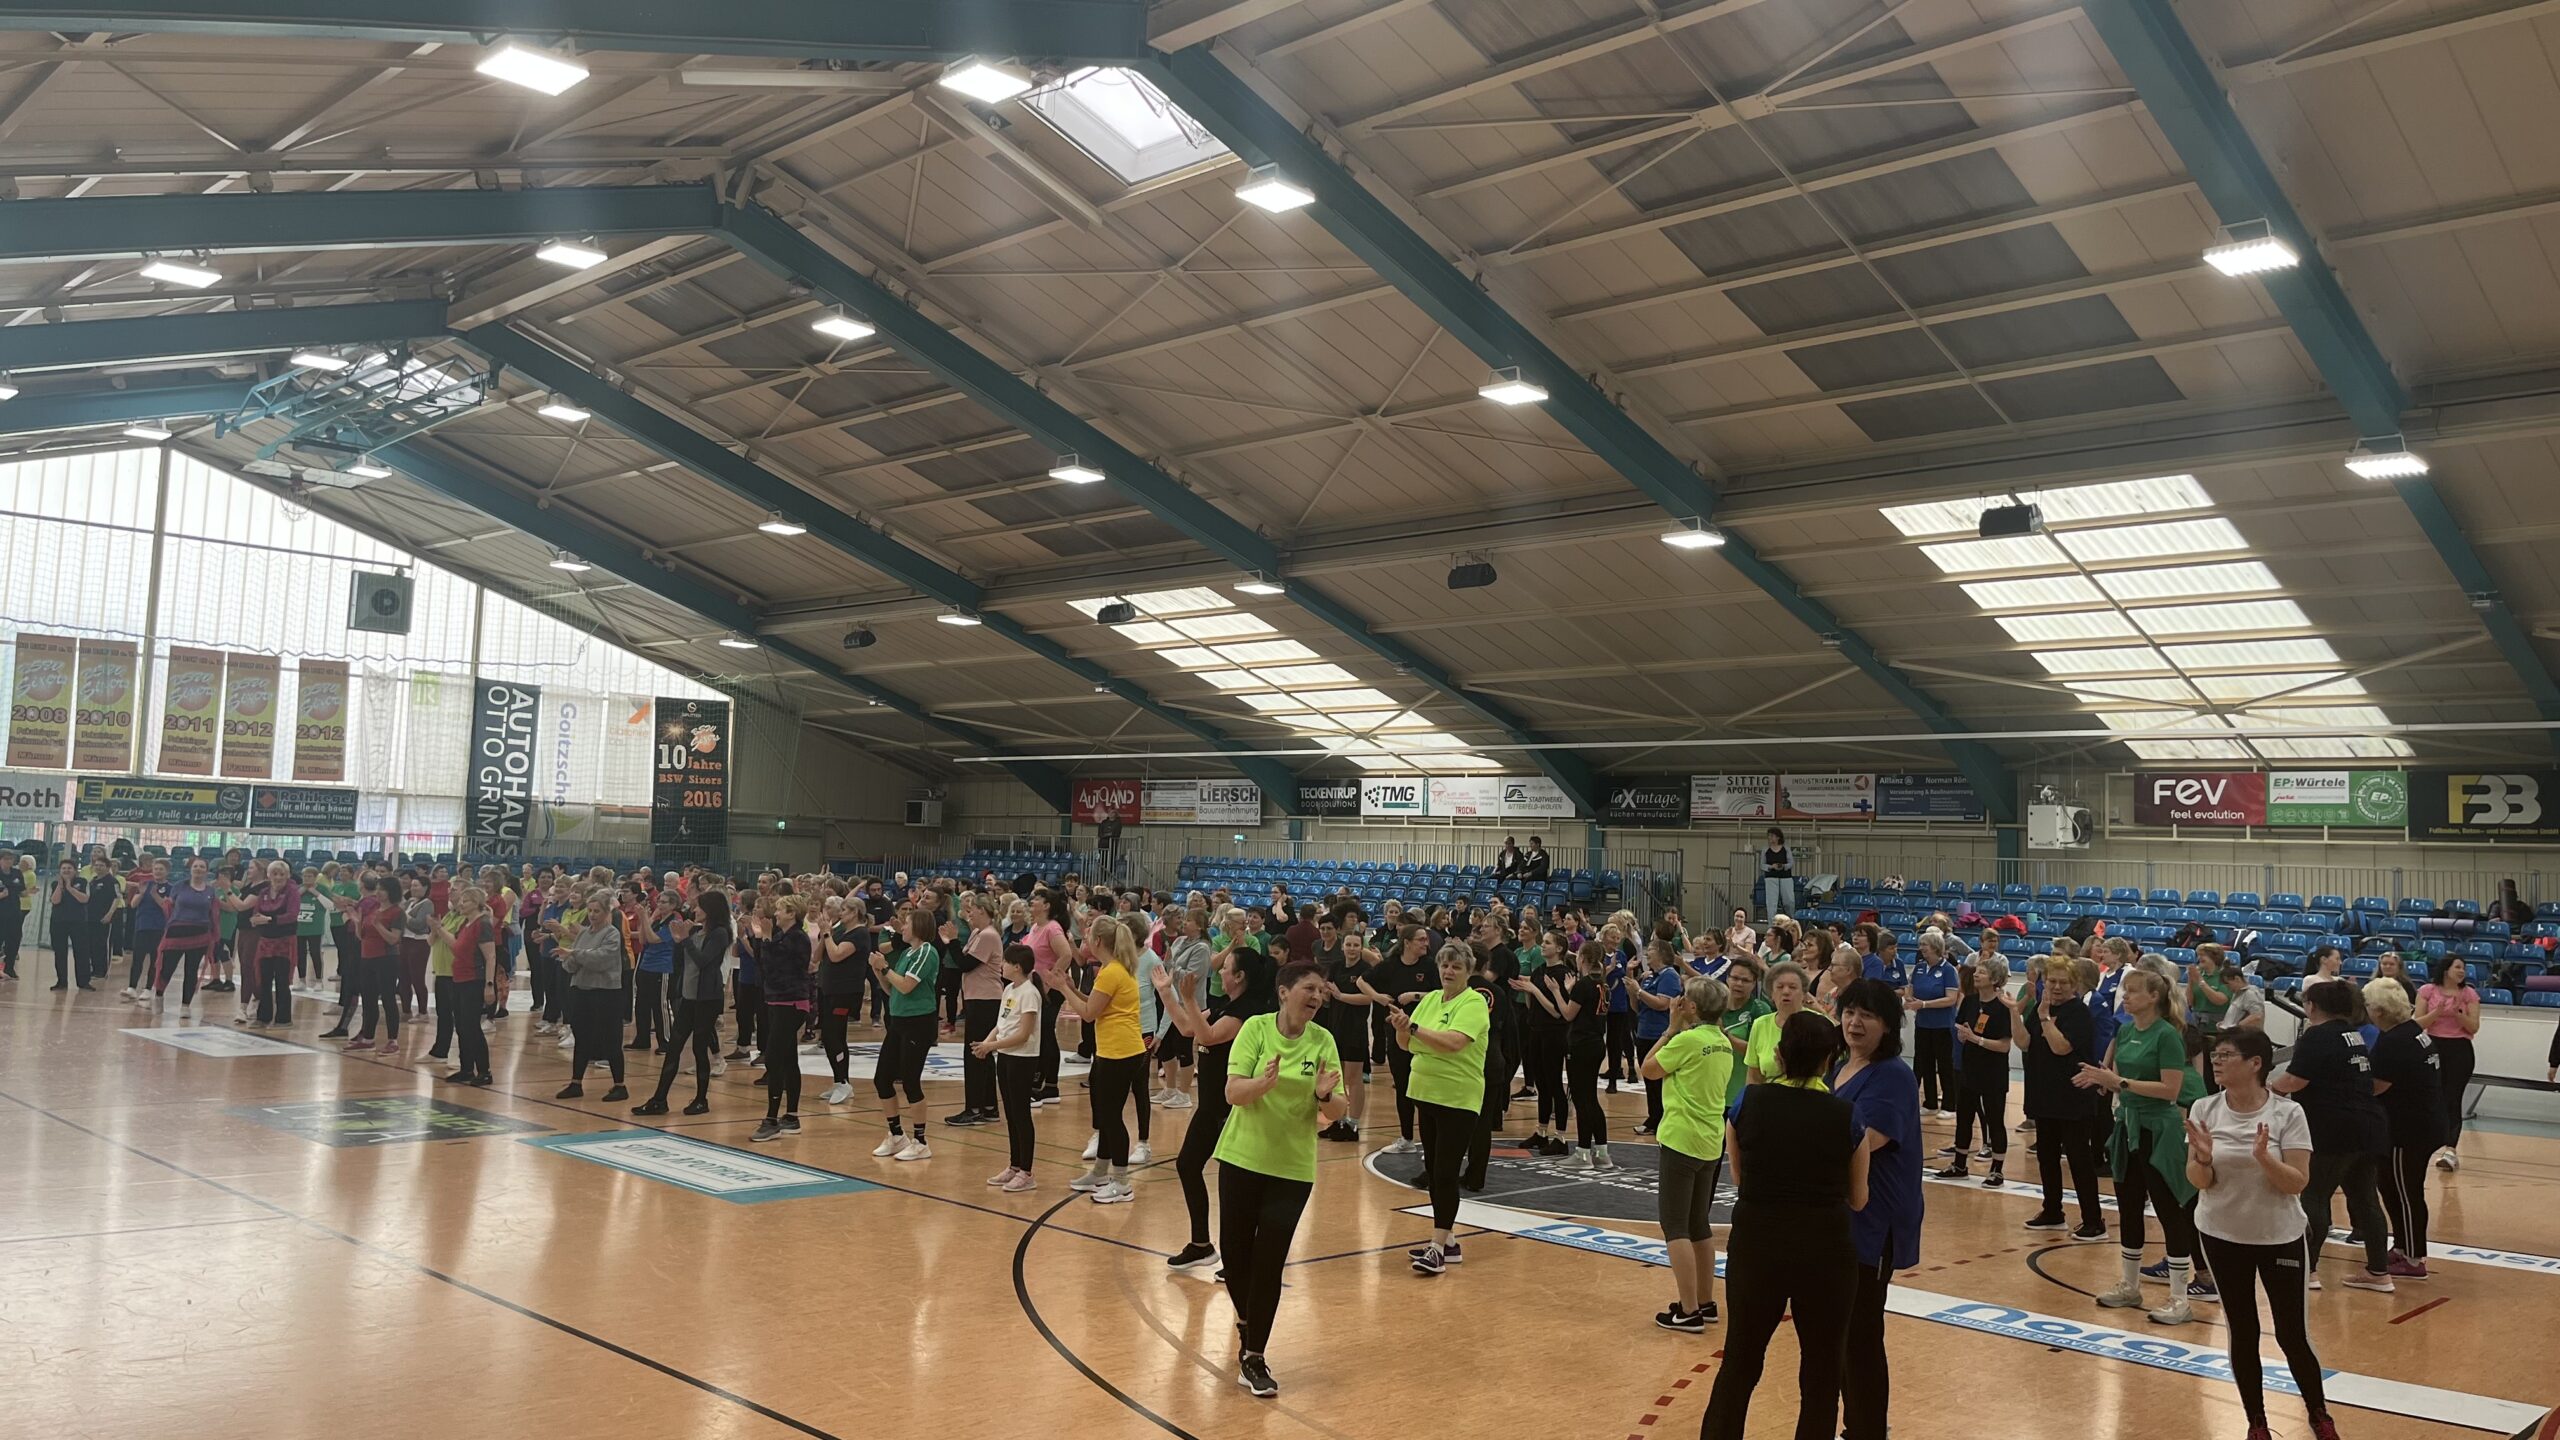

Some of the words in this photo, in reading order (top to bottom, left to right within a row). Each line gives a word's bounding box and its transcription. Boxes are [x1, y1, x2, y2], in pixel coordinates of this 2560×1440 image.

[11, 705, 68, 723] 2008
[76, 710, 131, 727] 2010
[483, 685, 510, 758] OTTO
[164, 714, 214, 733] 2011
[223, 720, 273, 738] 2012
[297, 725, 344, 741] 2012
[553, 702, 577, 808] Goitzsche
[658, 744, 687, 770] 10
[687, 756, 722, 770] Jahre
[498, 688, 535, 858] AUTOHAUS
[659, 774, 684, 784] BSW
[688, 774, 722, 785] Sixers
[1727, 776, 1769, 786] SITTIG
[0, 788, 60, 809] Roth
[110, 786, 195, 802] Niebisch
[280, 790, 355, 805] Rothkegel
[683, 790, 723, 809] 2016
[1079, 785, 1135, 809] AUTOLAND
[1300, 787, 1356, 799] TECKENTRUP
[1382, 786, 1415, 801] TMG
[281, 801, 293, 811] für
[295, 803, 310, 811] alle
[328, 804, 353, 813] bauen
[1199, 805, 1259, 817] Bauunternehmung
[1455, 806, 1477, 815] TROCHA
[1610, 810, 1635, 818] küchen
[2170, 810, 2192, 819] feel
[2194, 810, 2245, 819] evolution
[194, 810, 244, 824] Landsberg
[663, 1157, 773, 1182] APOTHEKE
[1943, 1311, 2108, 1356] INDUSTRIESERVICE
